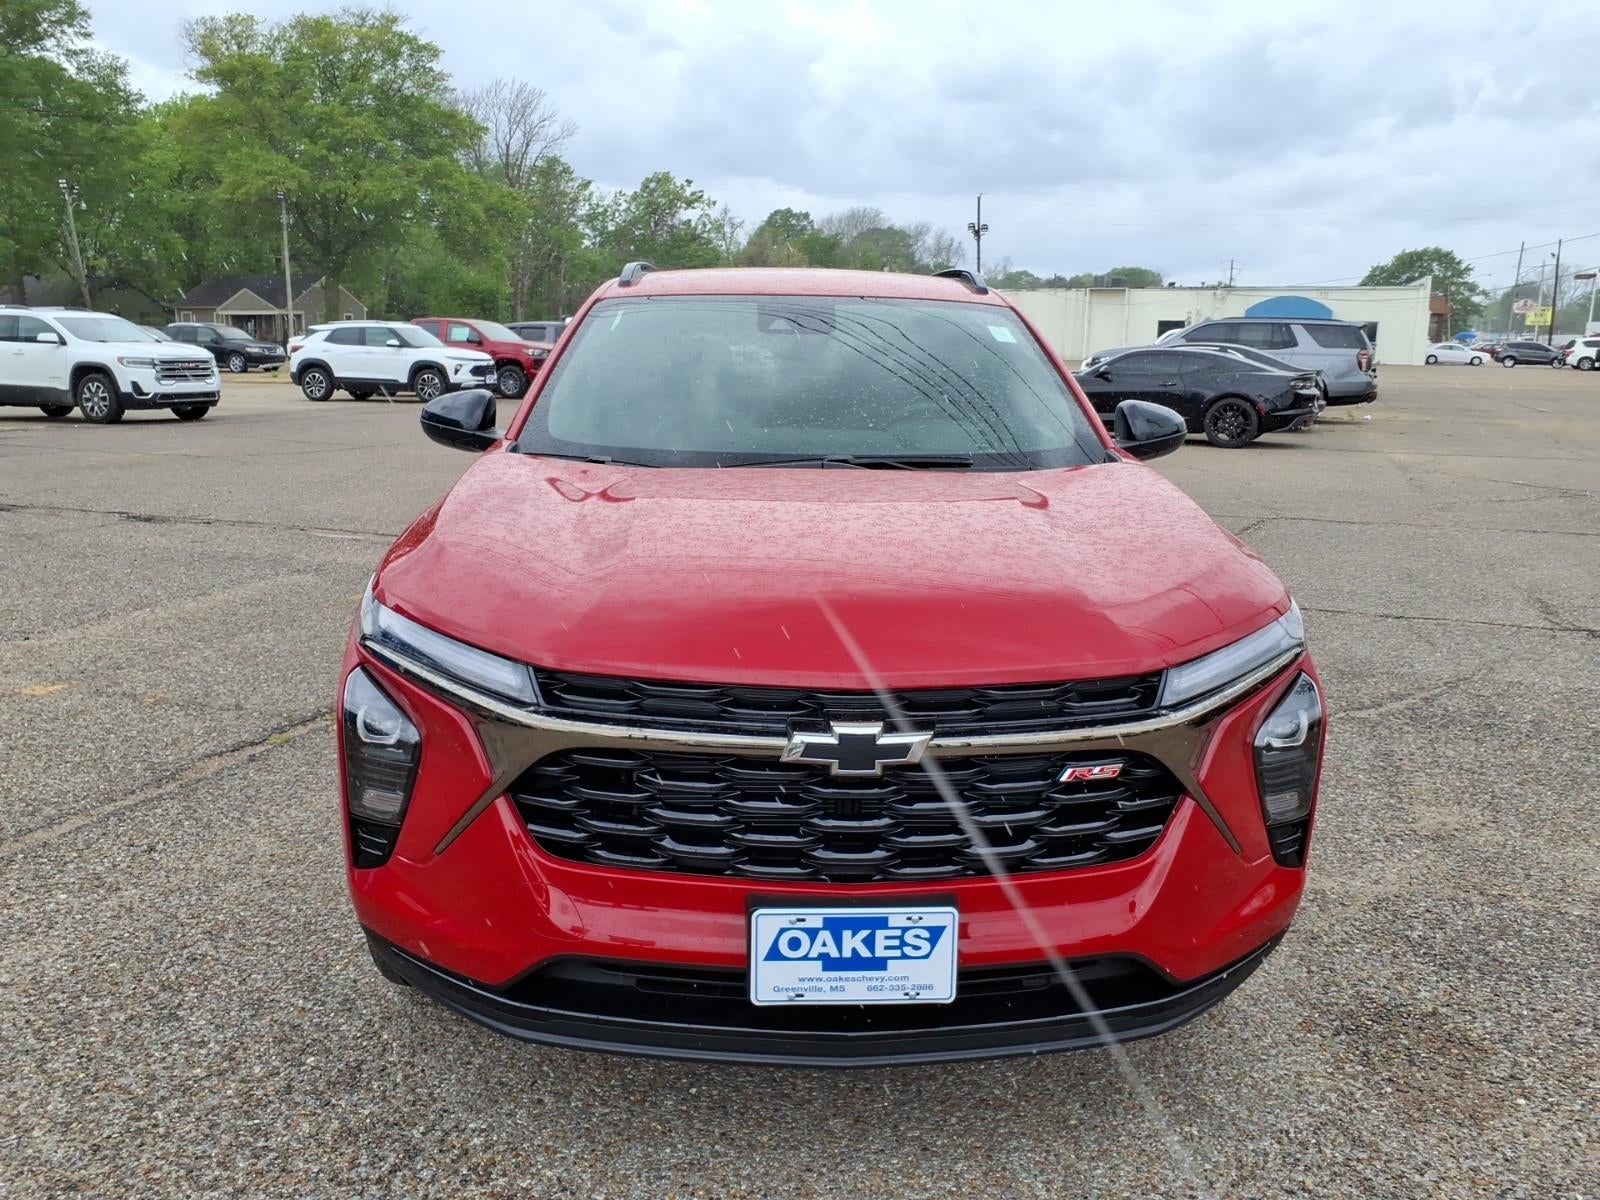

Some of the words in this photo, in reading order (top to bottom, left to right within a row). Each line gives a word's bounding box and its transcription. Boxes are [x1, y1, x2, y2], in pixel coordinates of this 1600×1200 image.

[1061, 764, 1121, 781] RS
[778, 928, 931, 958] OAKES
[798, 974, 910, 983] www.oakeschevy.com
[773, 985, 826, 993] Greenville,
[829, 985, 846, 993] MS
